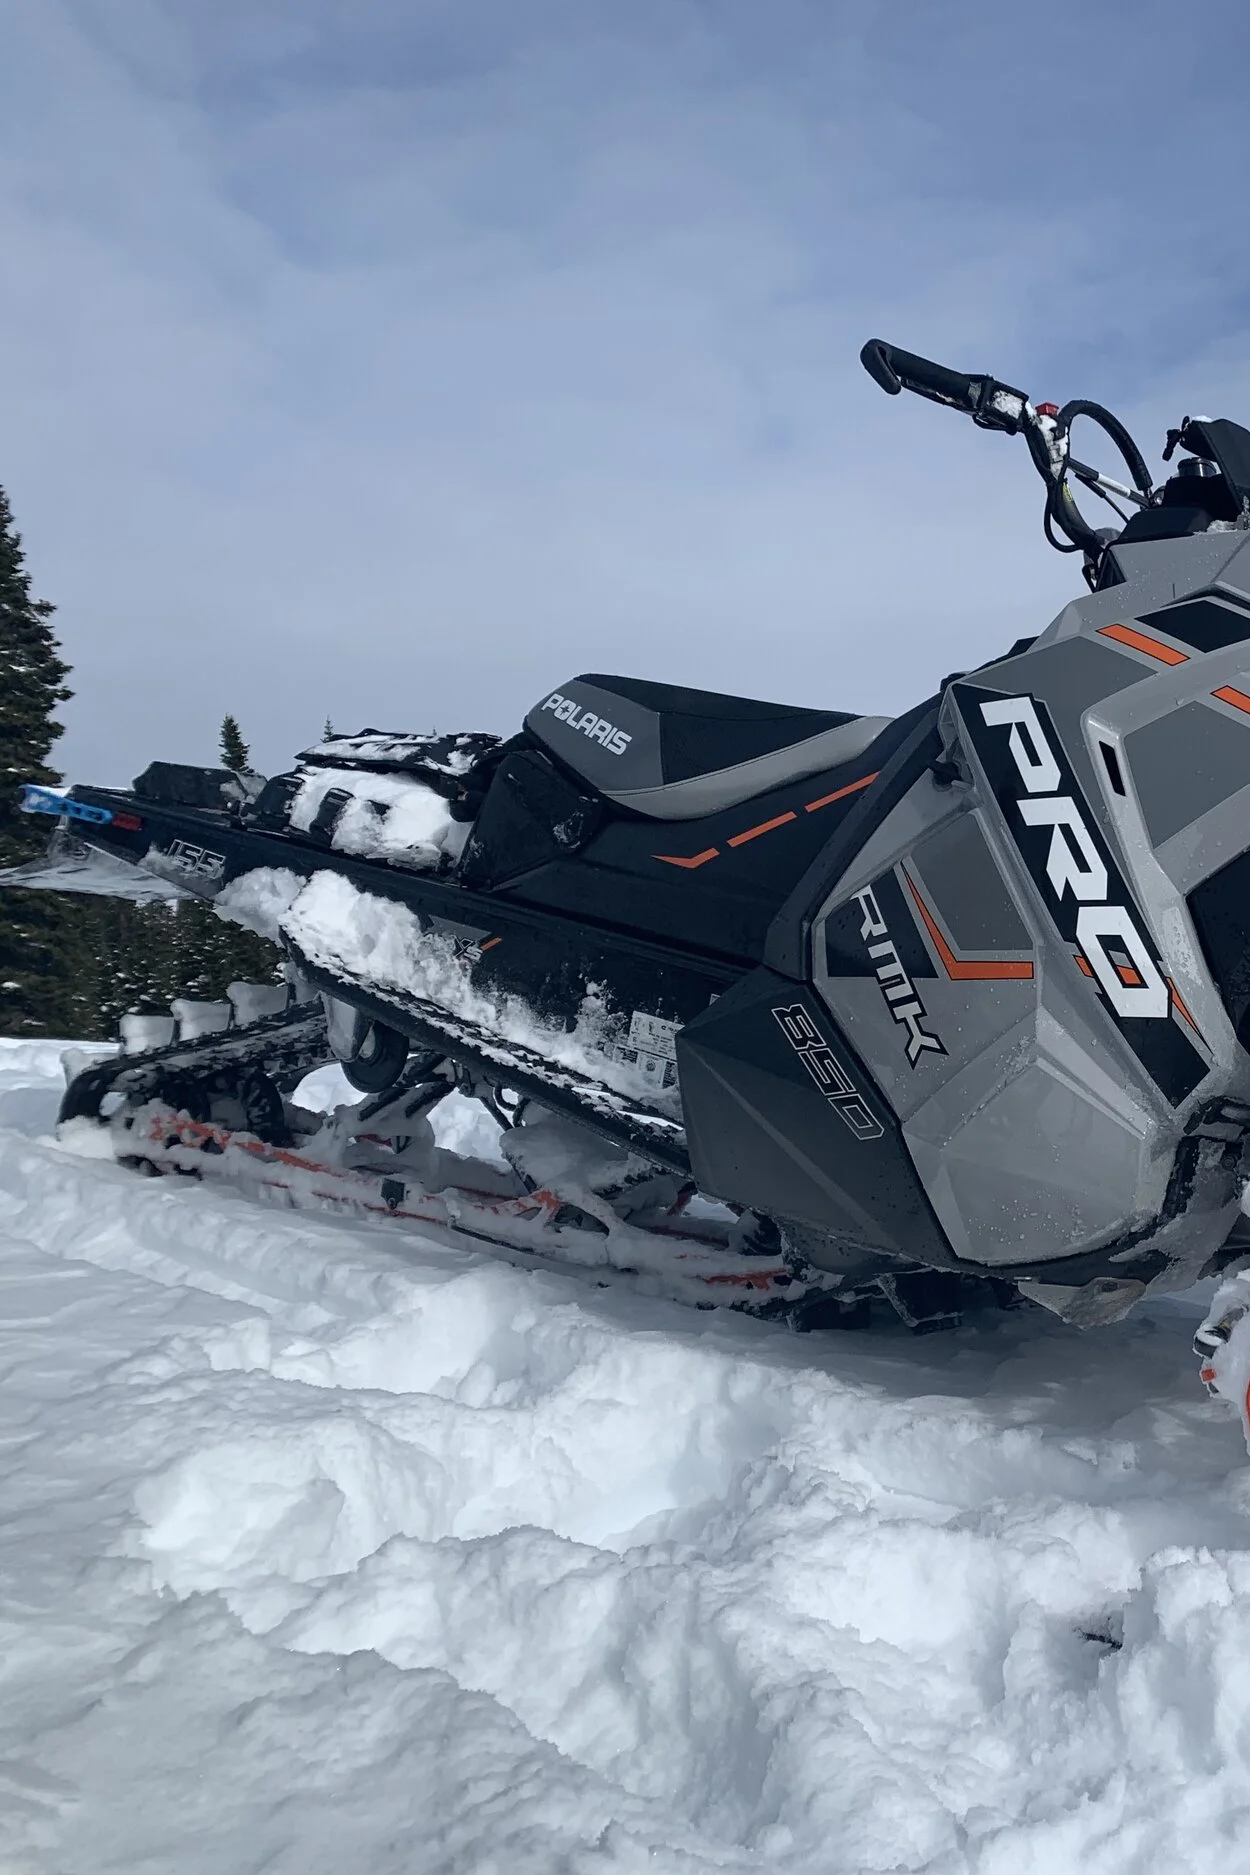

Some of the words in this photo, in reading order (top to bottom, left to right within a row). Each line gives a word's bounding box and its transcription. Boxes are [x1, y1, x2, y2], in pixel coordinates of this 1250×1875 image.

[541, 693, 632, 755] POLARIS
[979, 696, 1169, 1018] PRO
[850, 884, 947, 1068] RMK
[771, 1003, 885, 1141] 850
